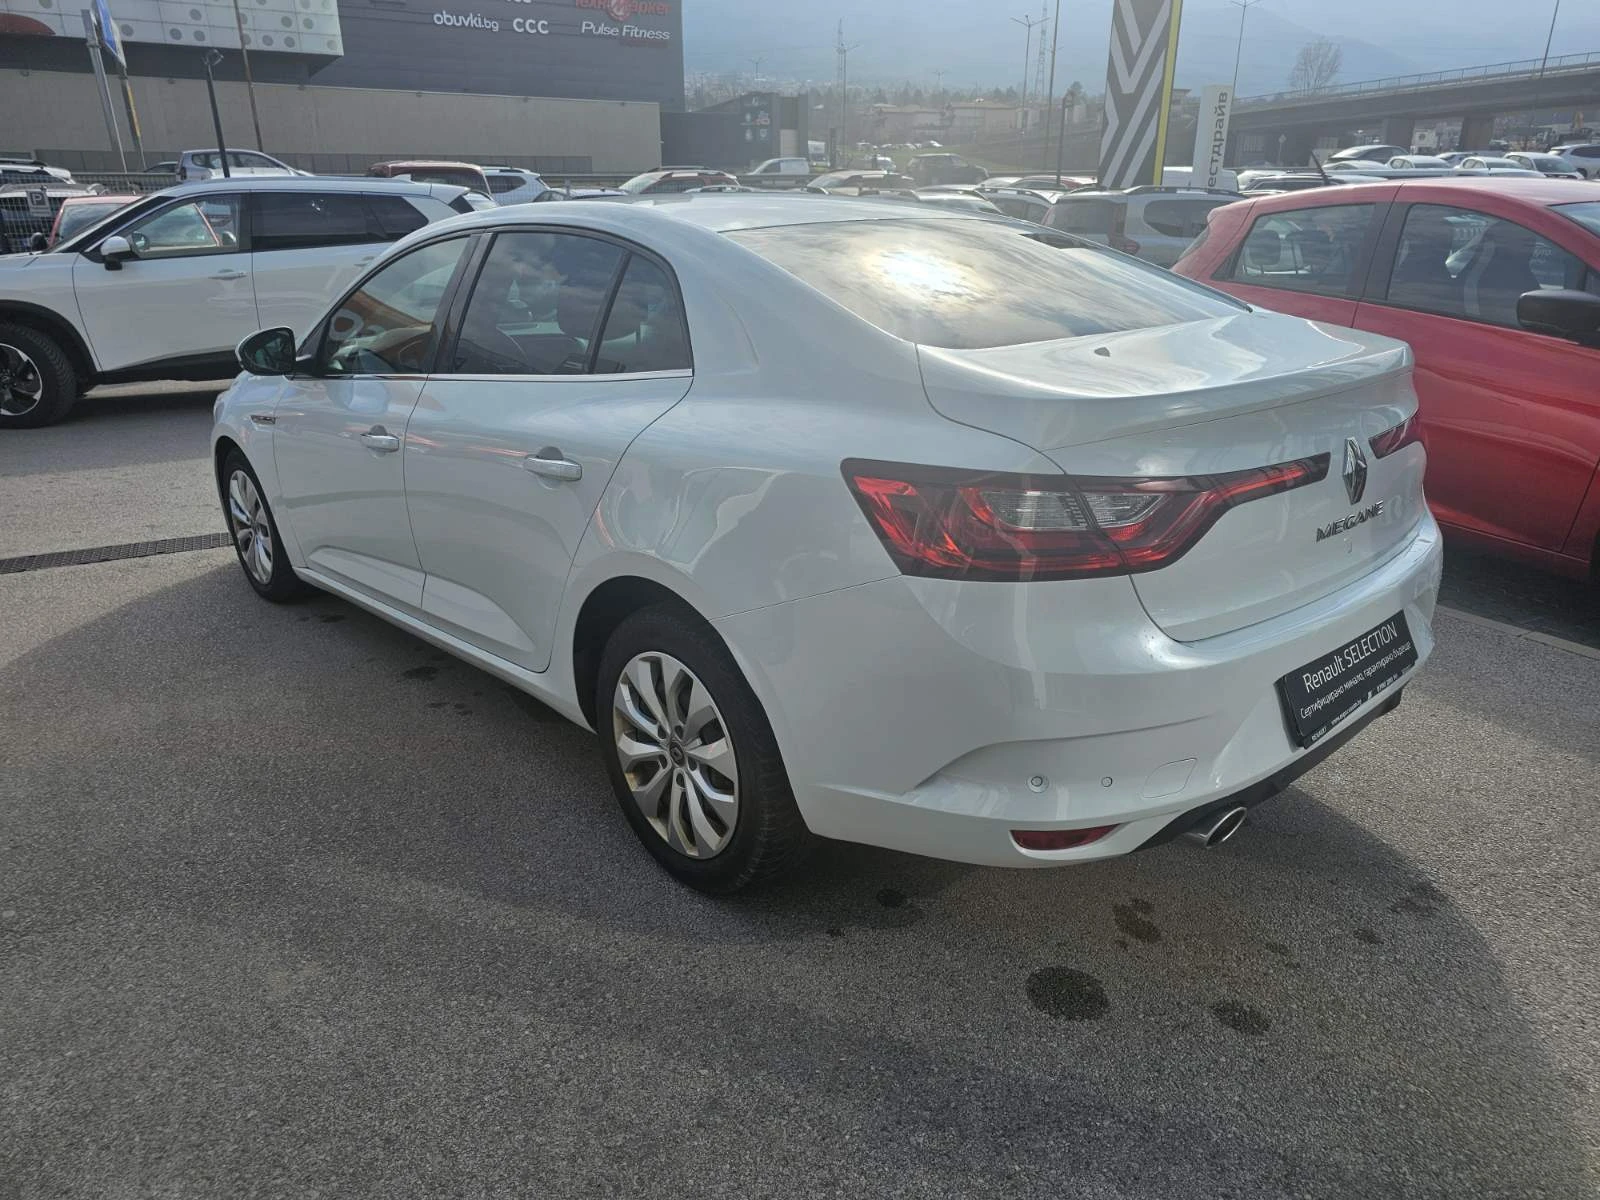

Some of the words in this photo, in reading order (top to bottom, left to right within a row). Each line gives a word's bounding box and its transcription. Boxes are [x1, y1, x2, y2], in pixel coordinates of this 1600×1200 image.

[433, 10, 499, 32] obuvki.bg
[581, 21, 619, 36] Pulse
[622, 24, 671, 40] Fitness
[1207, 92, 1228, 187] естдрайв
[1316, 499, 1384, 543] MEGANE
[1302, 655, 1346, 693] Renault
[1343, 621, 1398, 668] SELECTION
[1300, 685, 1345, 719] Сертифицирано
